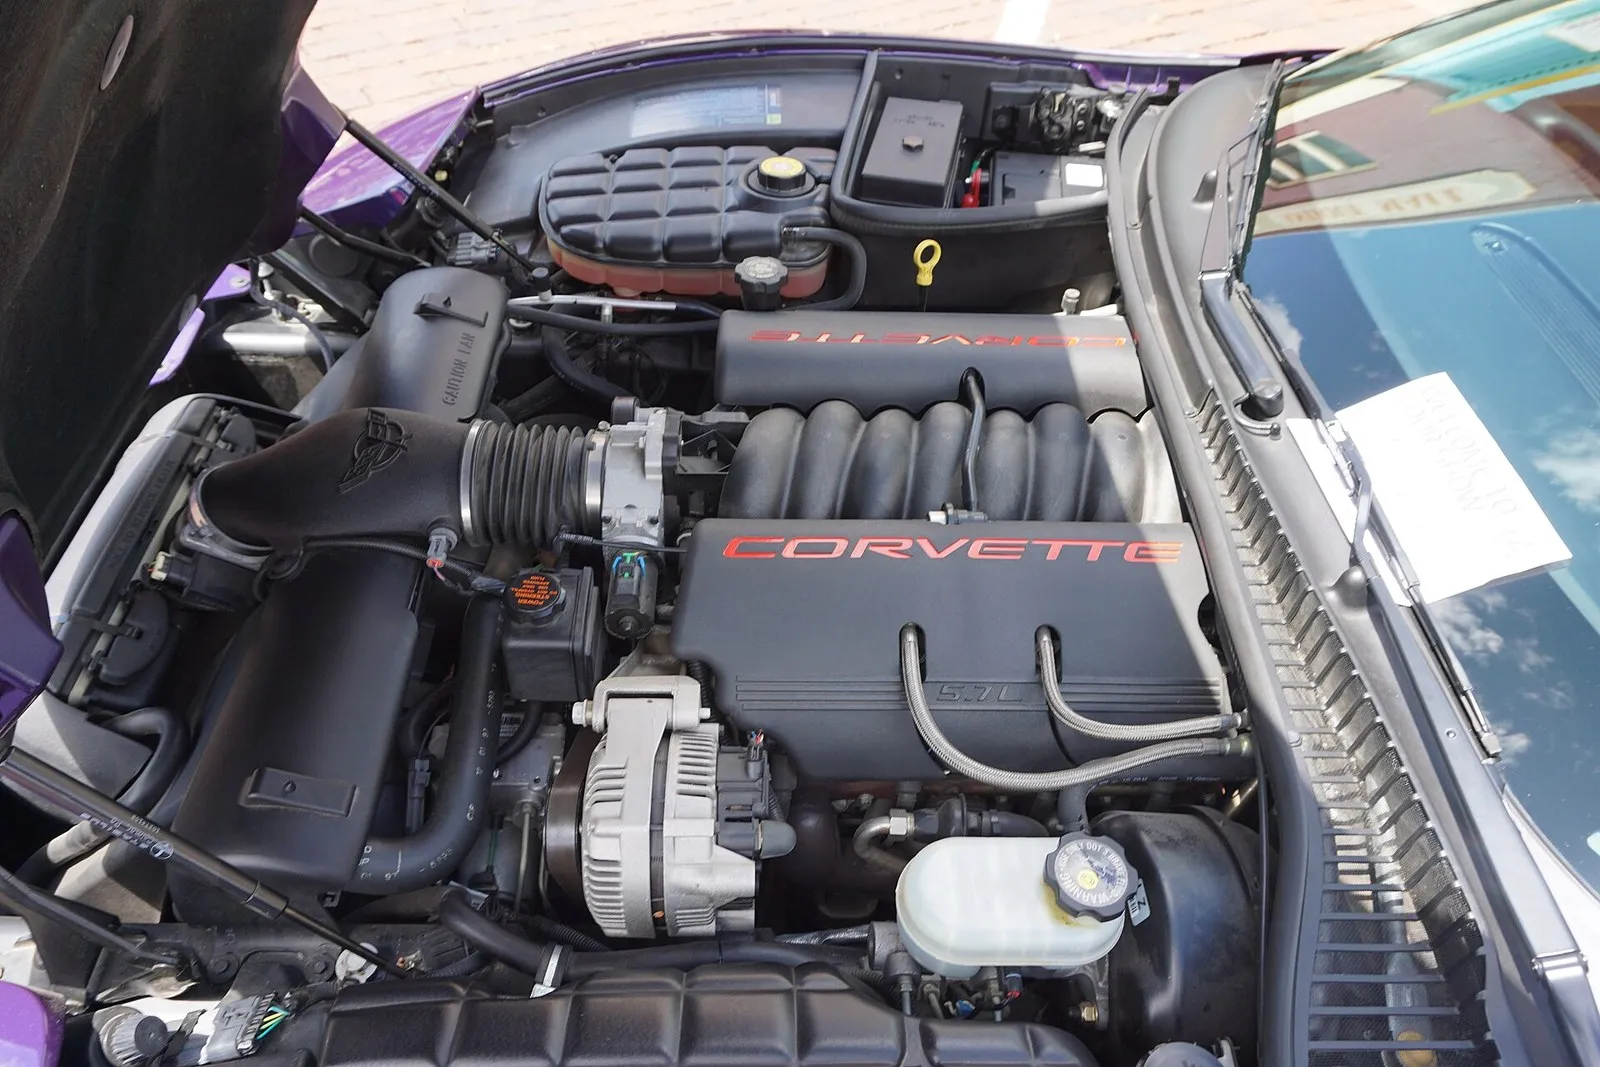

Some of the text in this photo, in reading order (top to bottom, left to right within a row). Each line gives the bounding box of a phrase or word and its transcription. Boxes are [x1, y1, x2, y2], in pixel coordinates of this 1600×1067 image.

[749, 330, 1127, 348] CORVETTE
[442, 358, 468, 406] CAUTION
[723, 536, 1184, 563] CORVETTE
[936, 684, 1023, 702] 5.7L
[1060, 872, 1111, 904] WARNING
